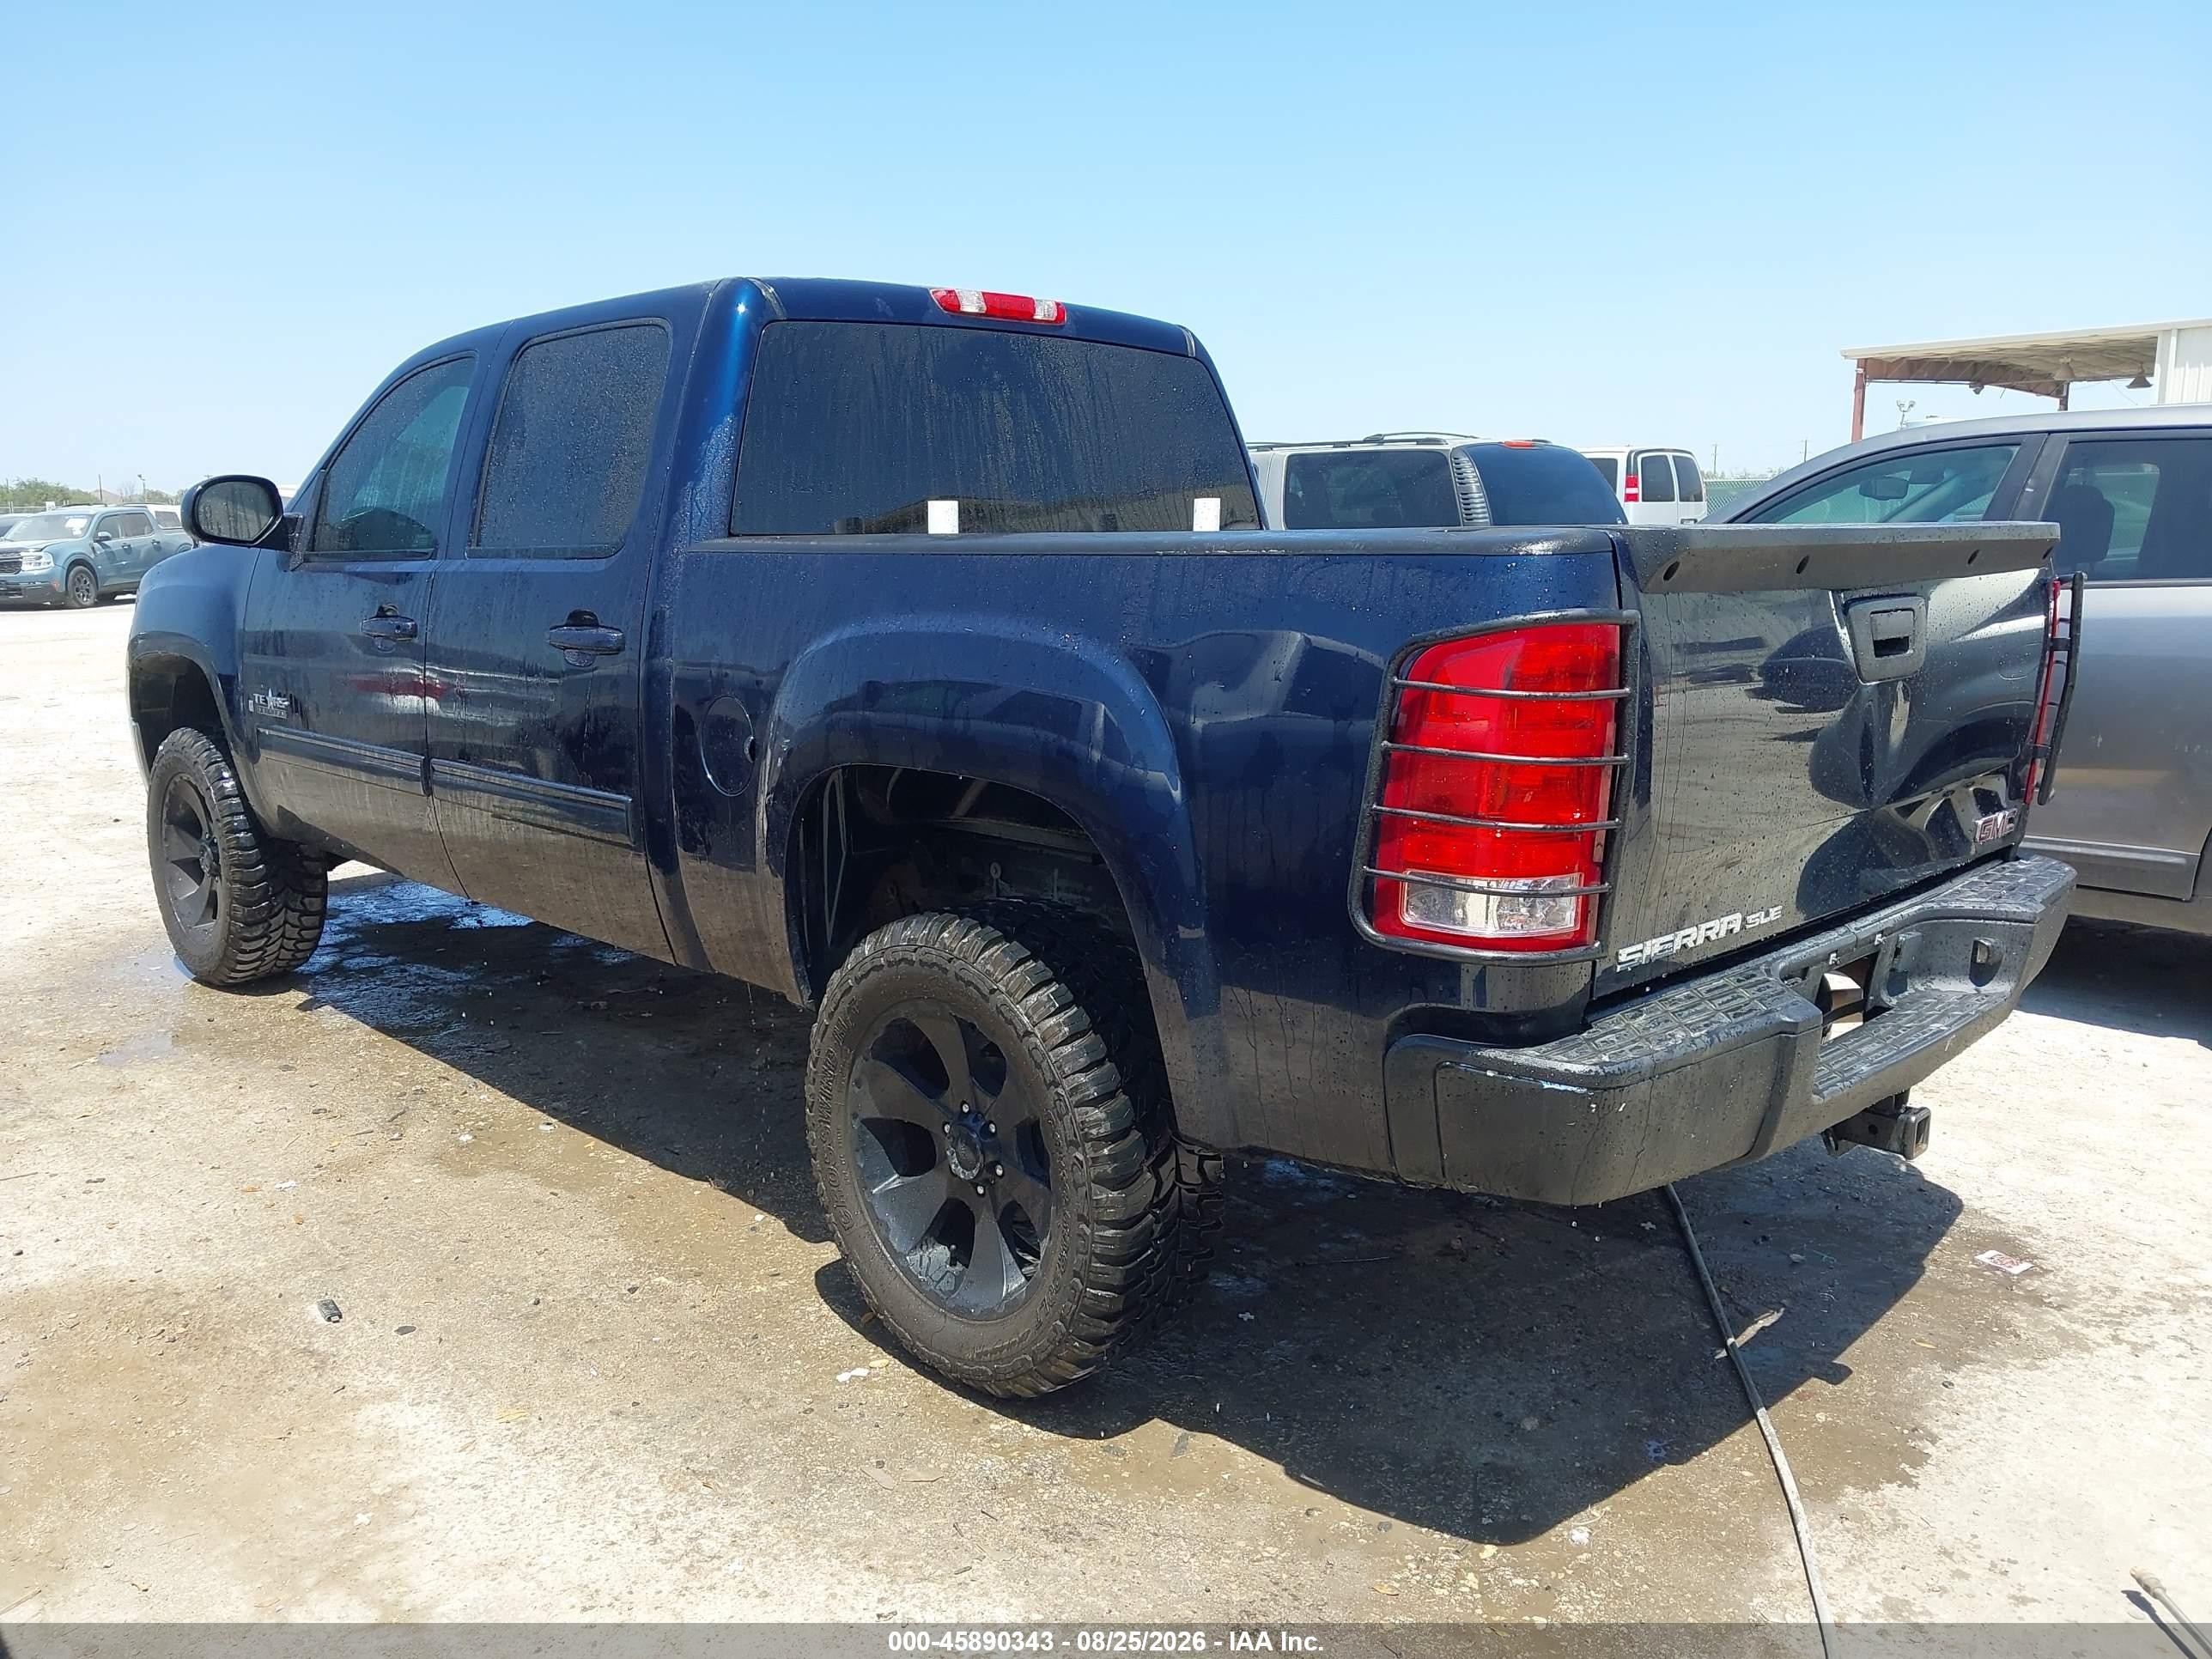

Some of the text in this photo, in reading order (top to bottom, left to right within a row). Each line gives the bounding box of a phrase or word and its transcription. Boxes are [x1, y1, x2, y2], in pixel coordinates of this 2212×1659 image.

[1978, 811, 2017, 842] GMC
[1615, 905, 1784, 973] SIERRA SLE
